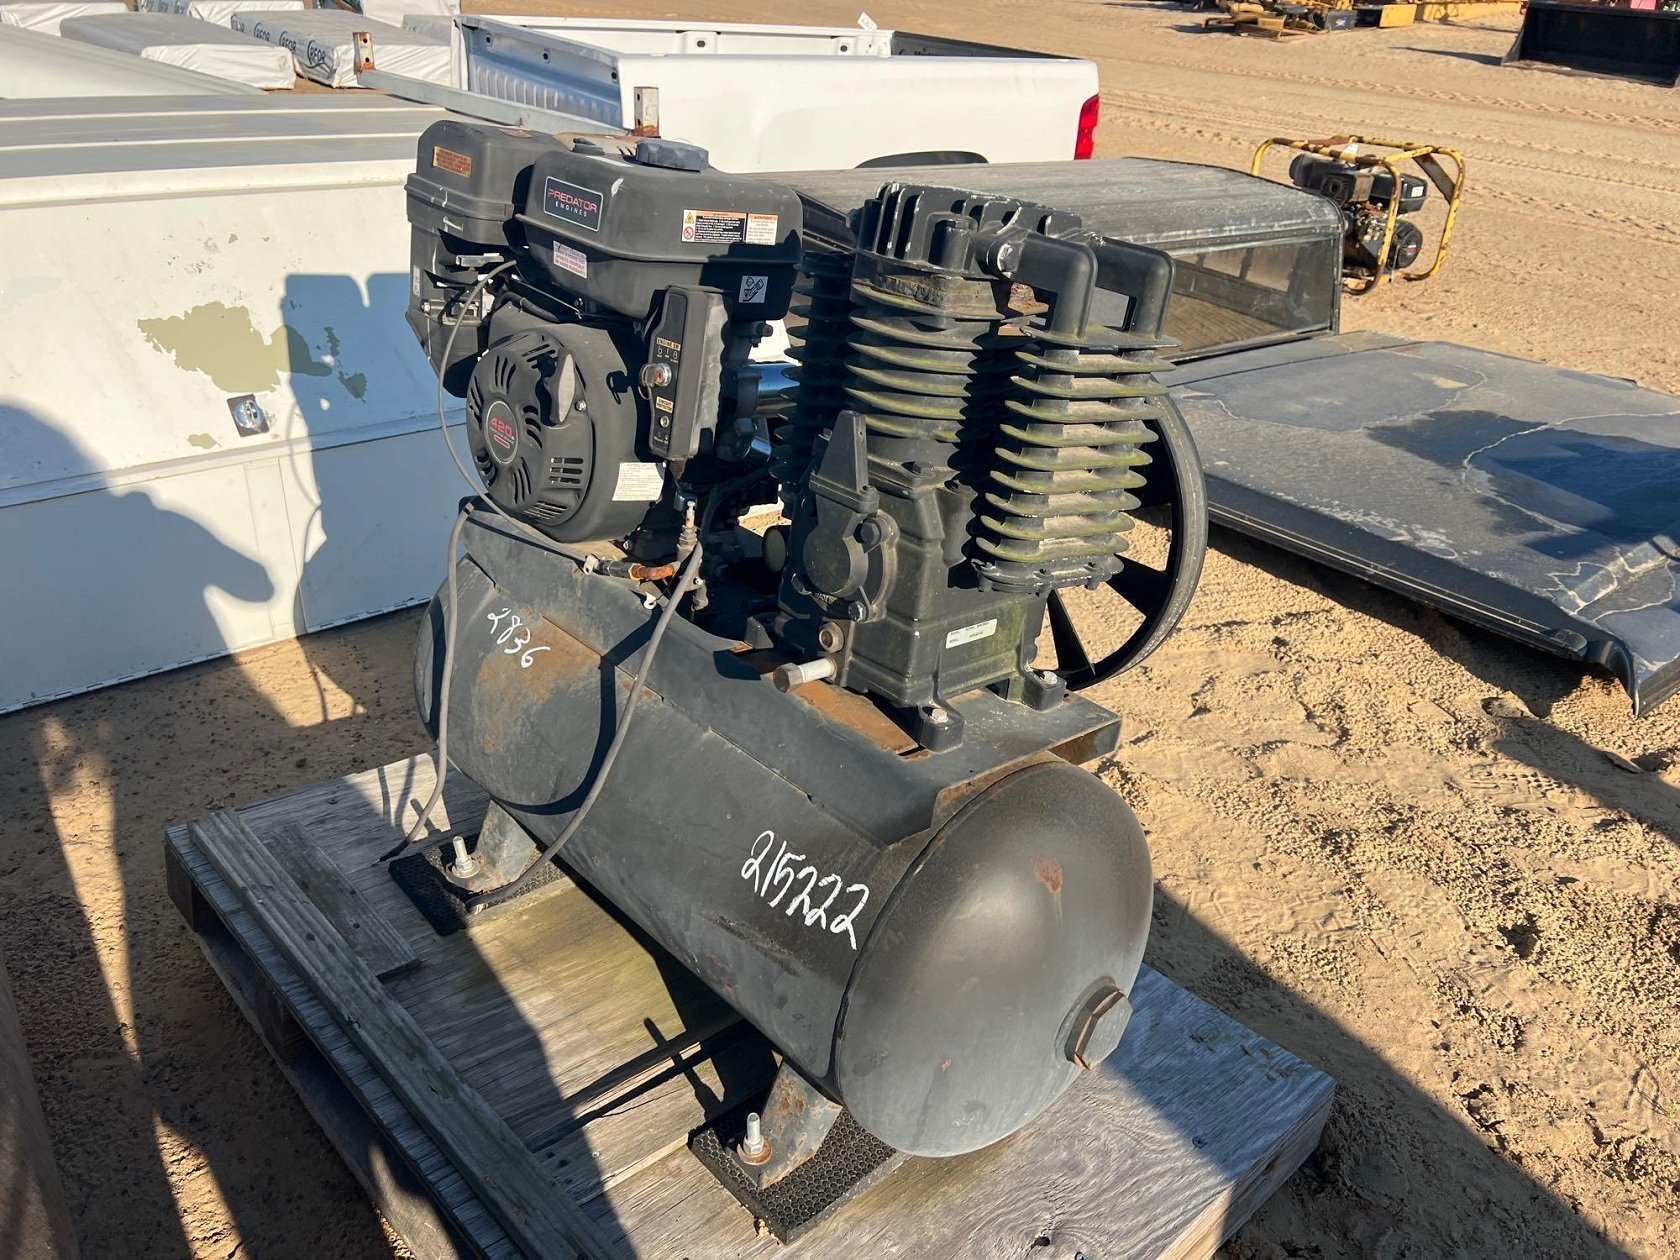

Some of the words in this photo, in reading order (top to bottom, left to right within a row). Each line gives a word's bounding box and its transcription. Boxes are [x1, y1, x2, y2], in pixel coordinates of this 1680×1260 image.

[547, 188, 598, 213] PREDATOR
[555, 200, 587, 218] ENGINES
[491, 417, 514, 439] 420
[487, 607, 551, 668] 2836
[741, 830, 870, 951] 215222
